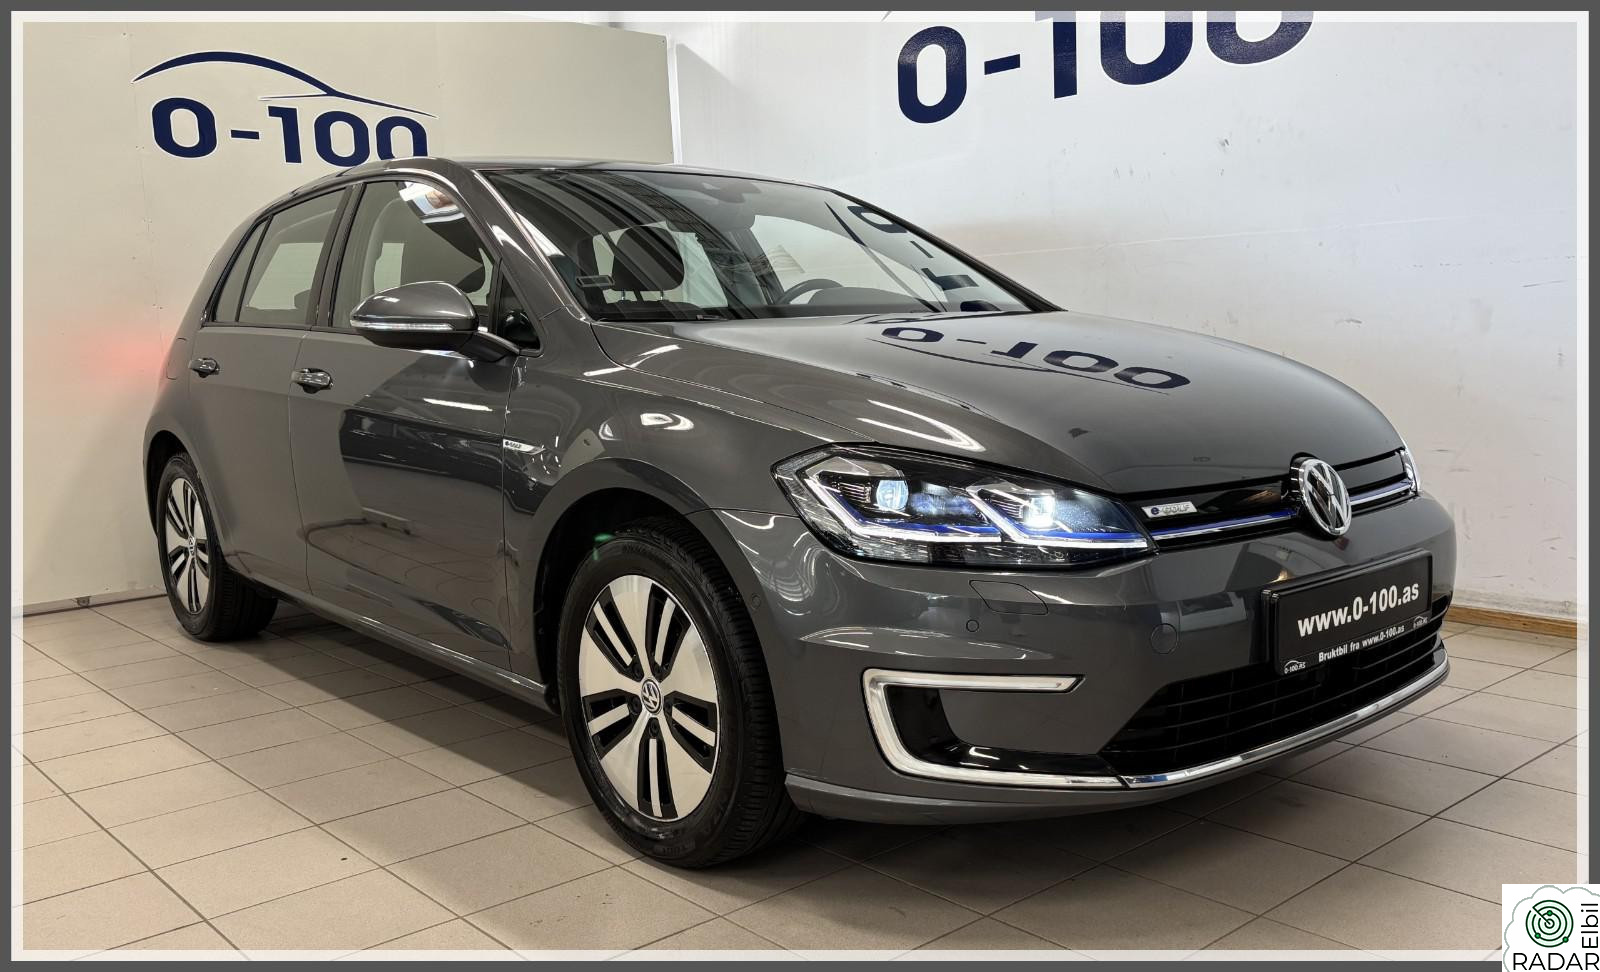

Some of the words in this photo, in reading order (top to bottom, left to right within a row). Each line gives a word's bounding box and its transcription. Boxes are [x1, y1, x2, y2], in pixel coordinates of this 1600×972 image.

[151, 97, 428, 166] 0-100
[1297, 583, 1420, 637] www.0-100.as
[1318, 645, 1348, 662] Bruktbil
[1350, 641, 1360, 652] fra
[1361, 625, 1405, 647] www.0-100.as
